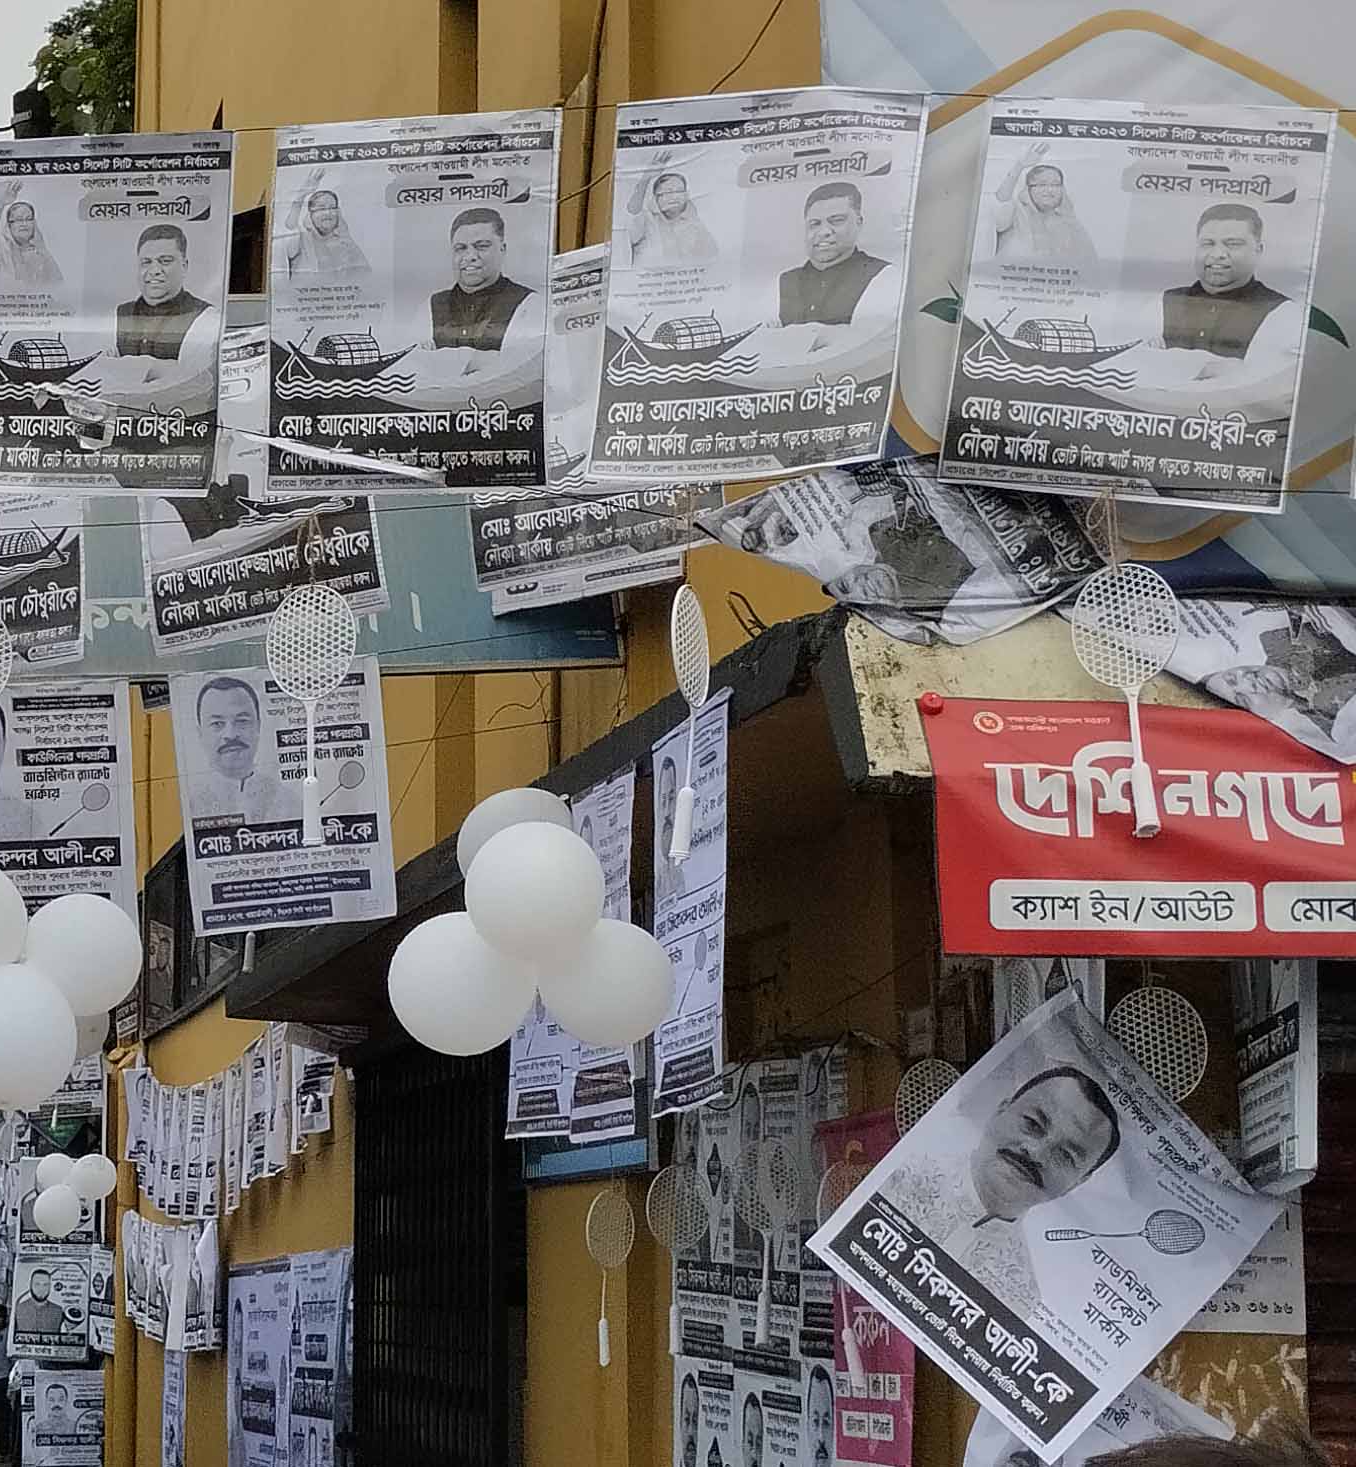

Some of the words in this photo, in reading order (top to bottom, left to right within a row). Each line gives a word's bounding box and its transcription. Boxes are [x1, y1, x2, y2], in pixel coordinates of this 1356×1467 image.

[707, 126, 741, 140] ২০২৩
[1047, 124, 1063, 136] ২১
[1092, 125, 1127, 137] ২০২৩
[1132, 126, 1168, 141] সিলেট
[53, 163, 80, 172] ২০২৩
[357, 148, 387, 160] ২০২৩
[749, 161, 797, 186] মেয়র
[1136, 173, 1191, 194] মেয়র
[397, 187, 443, 205] মেয়র
[89, 202, 130, 219] মেয়র
[608, 401, 644, 424] মোঃ
[650, 391, 795, 423] আনোয়ারুজ্জামান
[962, 395, 1001, 420] মোঃ
[1008, 399, 1176, 439] আনোয়ারুজ্জামান
[279, 416, 312, 438] মোঃ
[317, 411, 453, 439] আনোয়ারুজ্জামান
[6, 440, 41, 468] মার্কায়
[605, 426, 644, 457] নৌকা
[647, 426, 688, 456] মার্কায়
[957, 424, 998, 459] নৌকা
[1005, 431, 1050, 463] মার্কায়
[1052, 444, 1079, 466] ভোট
[1081, 445, 1105, 468] দিয়ে
[1132, 454, 1156, 472] নগর
[480, 518, 511, 540] মোঃ
[484, 538, 515, 568] নৌকা
[518, 529, 553, 561] মার্কায়
[156, 571, 185, 599] মোঃ
[161, 601, 201, 627] নৌকা
[205, 586, 248, 618] মার্কায়
[1158, 768, 1345, 845] নগদে
[199, 836, 232, 854] মোঃ
[323, 819, 372, 842] লী-কে
[44, 841, 116, 864] আলী-কে
[1011, 895, 1080, 921] ক্যাশ
[1091, 1243, 1163, 1313] ব্যাডমিন্টন
[863, 1217, 907, 1262] মোঃ
[904, 1247, 986, 1330] সিকন্দর
[985, 1317, 1074, 1405] আলী-কে
[1084, 1302, 1131, 1348] মার্কায়
